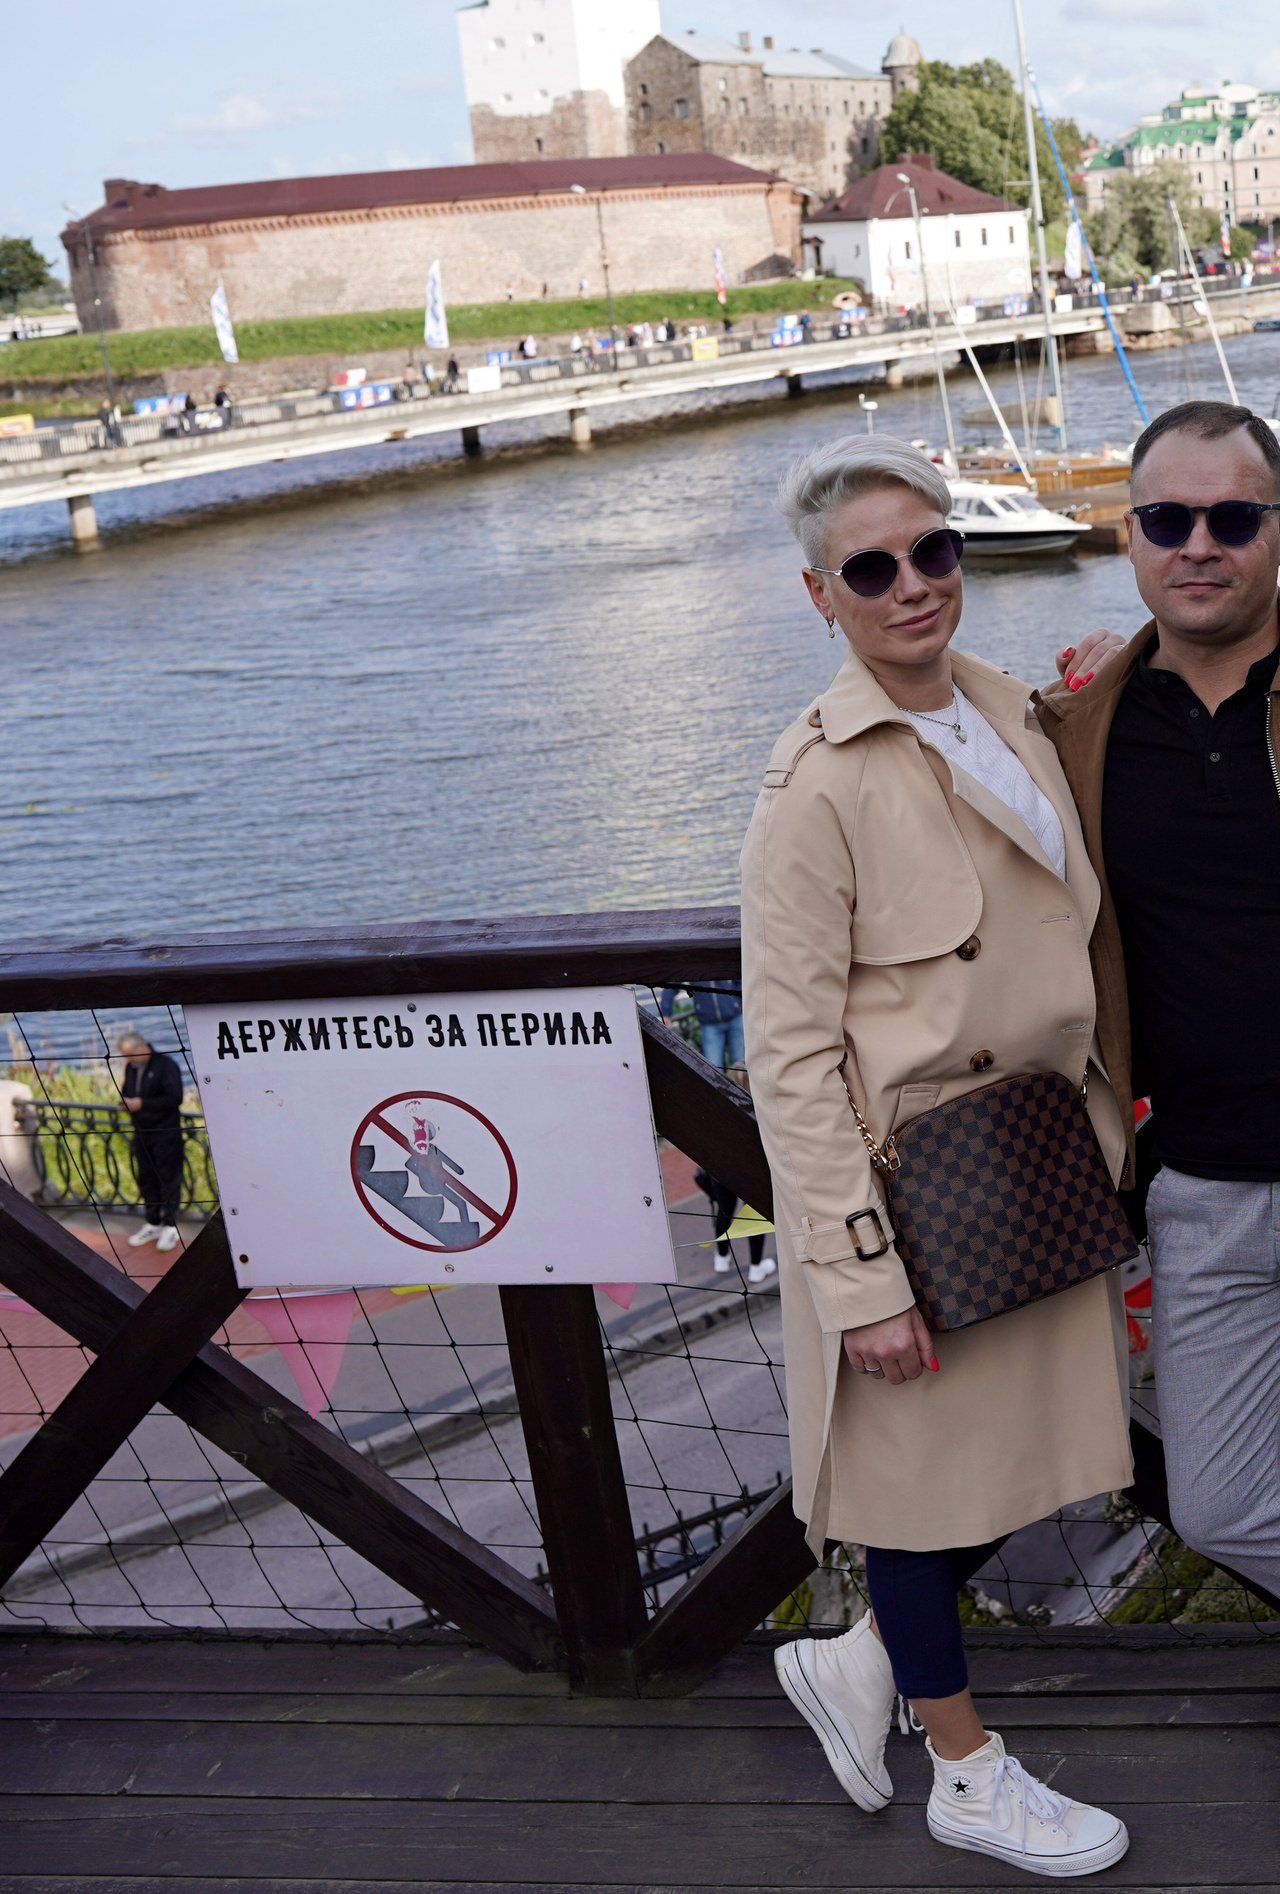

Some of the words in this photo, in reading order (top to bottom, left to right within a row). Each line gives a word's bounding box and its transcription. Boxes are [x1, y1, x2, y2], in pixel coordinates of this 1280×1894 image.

[216, 1014, 414, 1060] ДЕРЖИТЕСЬ
[425, 1013, 467, 1048] ЗА
[476, 1011, 613, 1047] ПЕРИЛА
